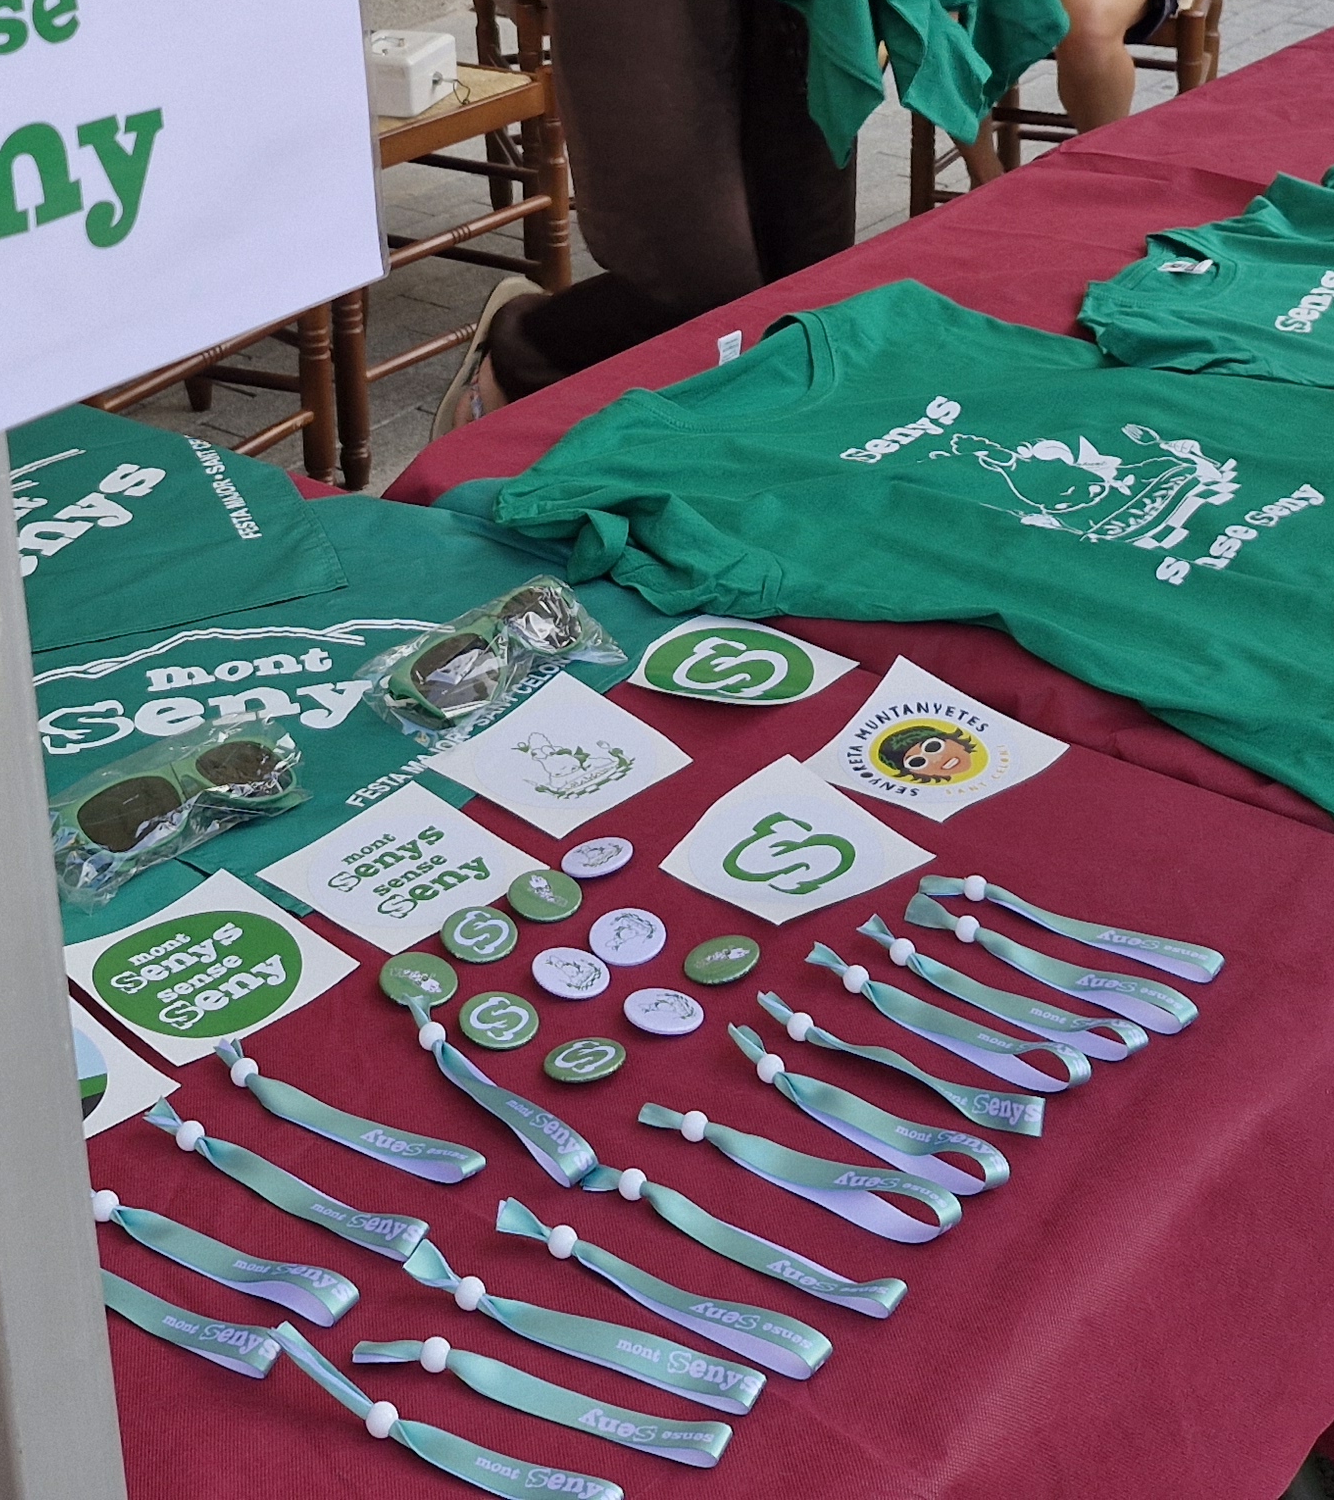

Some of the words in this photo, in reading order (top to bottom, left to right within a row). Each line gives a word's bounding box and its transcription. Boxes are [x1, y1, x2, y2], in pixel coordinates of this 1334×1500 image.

[840, 395, 961, 463] Senys
[213, 477, 246, 510] MAJOR
[230, 507, 263, 540] FESTA
[1156, 525, 1258, 585] snse
[1244, 483, 1325, 527] Seny
[146, 647, 333, 692] mont
[38, 678, 390, 755] Seny
[855, 701, 989, 741] MUNTANYETES
[346, 770, 413, 808] FESTA
[847, 745, 920, 797] SENYORETA
[327, 825, 445, 892] Senys
[341, 832, 396, 866] mont
[372, 853, 447, 897] sense
[377, 856, 491, 918] Seny
[110, 922, 244, 994] Senys
[128, 932, 191, 967] mont
[156, 953, 244, 1004] sense
[158, 953, 287, 1030] Seny
[971, 1093, 1042, 1125] Senys
[360, 1128, 425, 1156] Seny
[529, 1112, 594, 1172] Senys
[895, 1125, 932, 1142] mont
[347, 1213, 422, 1243] Senys
[162, 1314, 199, 1336] mont
[199, 1323, 282, 1361] Senys
[689, 1302, 760, 1330] Seny
[616, 1339, 662, 1362] mont
[667, 1350, 761, 1394] Senys
[578, 1408, 657, 1442] Seny
[475, 1456, 521, 1479] mont
